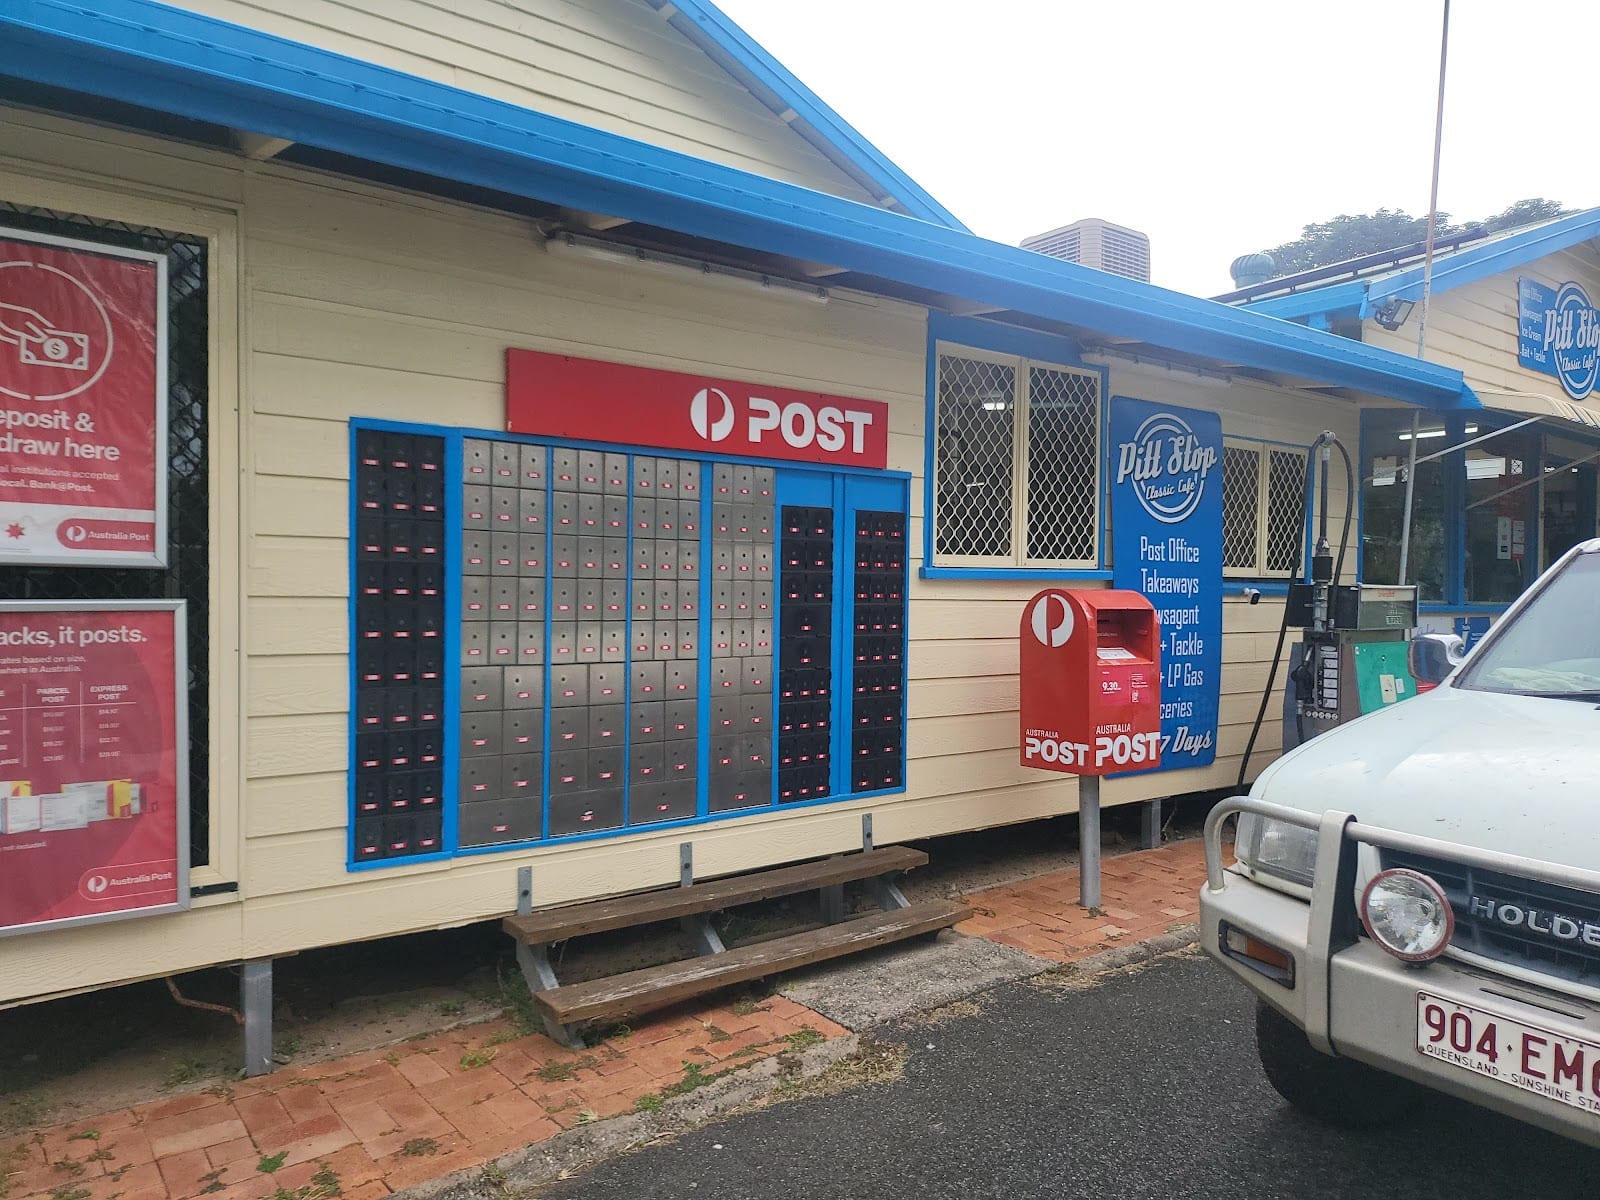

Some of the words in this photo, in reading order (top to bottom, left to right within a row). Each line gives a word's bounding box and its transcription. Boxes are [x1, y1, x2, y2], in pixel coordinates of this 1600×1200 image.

[1544, 309, 1574, 351] Pitt
[1563, 357, 1581, 372] Classic
[74, 412, 95, 432] &
[749, 396, 873, 453] POST
[65, 437, 120, 461] here
[1117, 443, 1162, 484] Pitt
[1167, 434, 1217, 478] Stop
[11, 465, 71, 478] institutions
[1146, 484, 1175, 500] Classic
[88, 530, 128, 540] Australia
[129, 533, 150, 541] Post
[1141, 536, 1165, 561] Post
[1169, 538, 1199, 562] Office
[1141, 568, 1199, 598] Takeaways
[1156, 605, 1199, 630] wsagent
[59, 626, 75, 644] it
[79, 625, 147, 647] posts.
[1160, 640, 1167, 651] +
[1170, 631, 1203, 656] Tackle
[1168, 664, 1181, 687] LP
[1184, 663, 1203, 686] Gas
[90, 684, 128, 692] EXPRESS
[1160, 697, 1193, 719] ceries
[1026, 729, 1059, 738] AUSTRALIA
[1096, 723, 1132, 735] AUSTRALIA
[1172, 726, 1213, 756] Days
[1025, 738, 1089, 766] POST
[1095, 732, 1160, 766] POST
[110, 876, 150, 886] Australia
[151, 872, 172, 881] Post
[1427, 1044, 1499, 1076] QUEENSLAND
[1511, 1073, 1571, 1101] SUNSHINE
